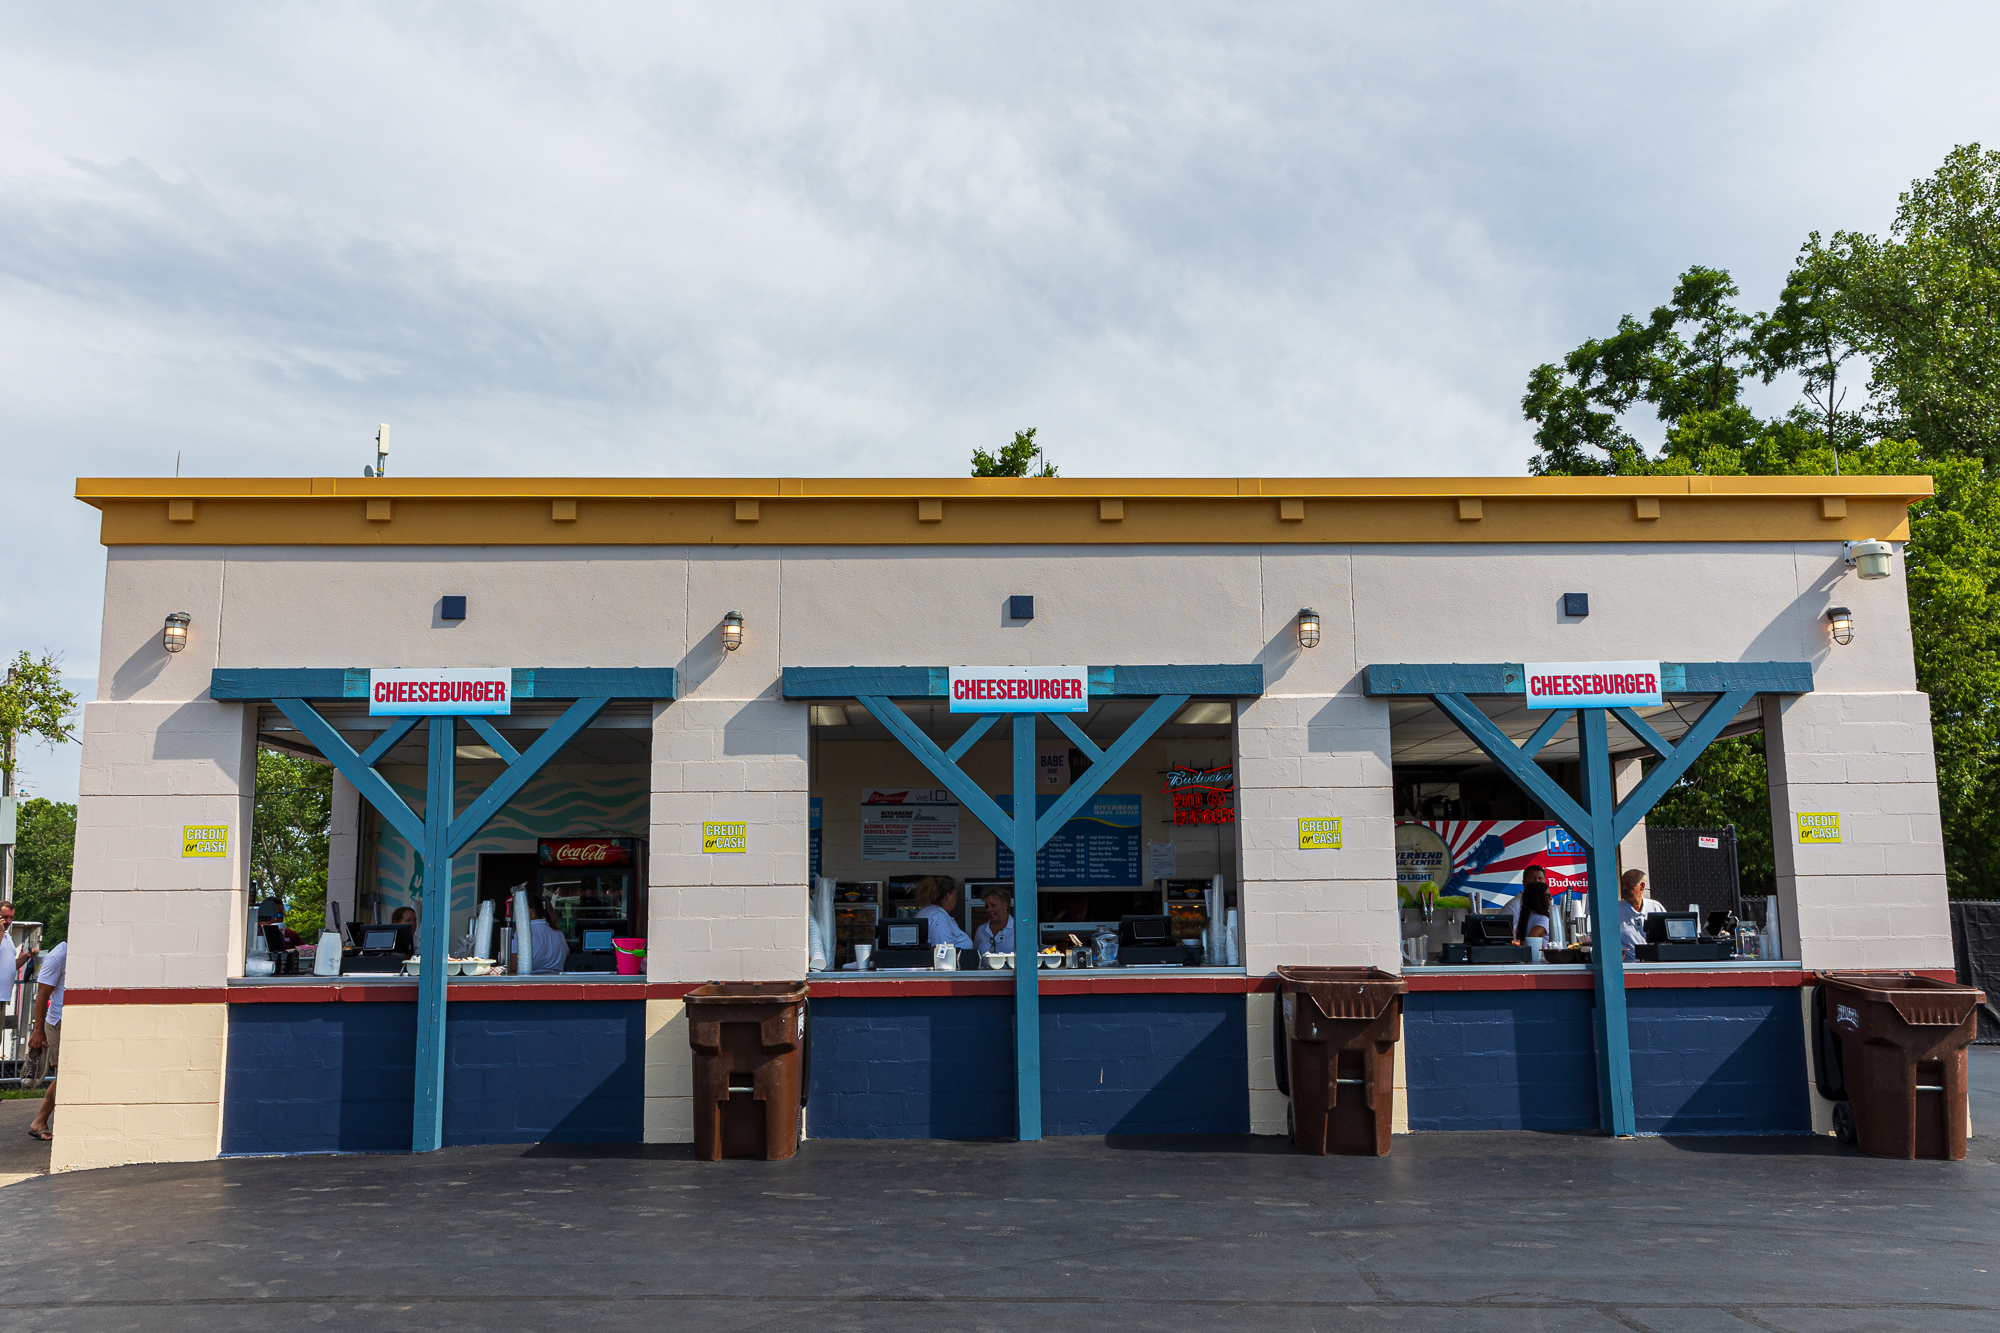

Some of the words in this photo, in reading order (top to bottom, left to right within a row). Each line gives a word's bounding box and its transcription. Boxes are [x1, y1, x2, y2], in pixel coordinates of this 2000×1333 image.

[954, 678, 1082, 700] CHEESEBURGER
[1530, 673, 1657, 696] CHEESEBURGER
[374, 681, 506, 703] CHEESEBURGER
[1040, 755, 1064, 767] BABE
[1166, 771, 1233, 786] Budweise
[869, 793, 906, 801] Budweiser
[1172, 792, 1203, 809] BUD
[1209, 790, 1224, 807] &
[1301, 820, 1340, 832] CREDIT
[1800, 815, 1837, 827] CREDIT
[186, 828, 227, 840] CREDIT
[706, 824, 745, 836] CREDIT
[1801, 830, 1812, 838] or
[1811, 827, 1840, 839] CASH
[705, 839, 717, 848] or
[716, 837, 745, 848] CASH
[1302, 835, 1313, 843] or
[1312, 832, 1341, 844] CASH
[185, 843, 197, 852] or
[196, 841, 226, 853] CASH
[556, 843, 610, 861] Coca-Cola
[1550, 841, 1586, 853] LIGH
[1547, 877, 1589, 887] Budweis
